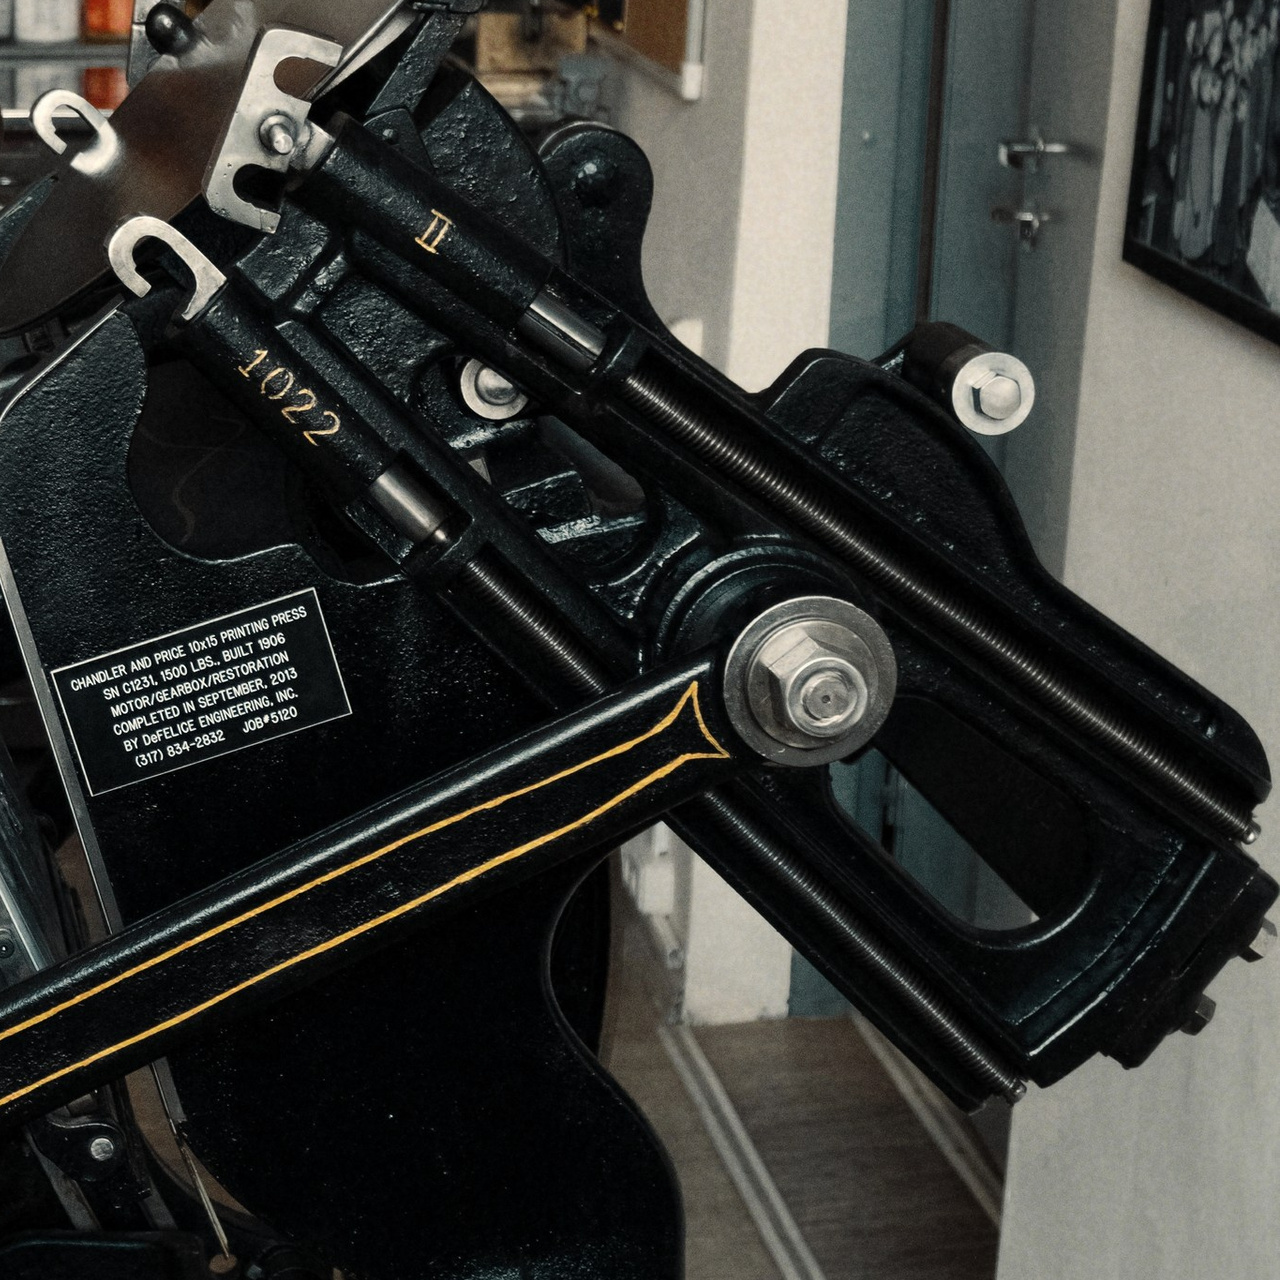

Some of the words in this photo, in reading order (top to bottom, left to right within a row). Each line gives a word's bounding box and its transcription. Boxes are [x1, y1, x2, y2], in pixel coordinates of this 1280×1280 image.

[238, 349, 340, 445] 1022
[70, 664, 128, 692] CHANDLER
[130, 656, 152, 673] AND
[153, 644, 187, 665] PRICE
[188, 634, 218, 654] 10x15
[219, 618, 270, 644] PRINTING
[270, 605, 307, 627] PRESS
[102, 685, 120, 700] SN
[122, 674, 158, 694] C1231,
[160, 663, 188, 682] 1500
[189, 655, 221, 673] LBS.,
[221, 641, 254, 662] BUILT
[257, 632, 286, 650] 1906
[110, 650, 290, 718] MOTOR/GEARBOX/RESTORATION
[112, 704, 180, 736] COMPLETED
[182, 700, 196, 714] IN
[197, 677, 268, 709] SEPTEMBER,
[269, 666, 298, 686] 2013
[122, 736, 138, 752] BY
[141, 718, 197, 746] DeFELICE
[197, 695, 274, 728] ENGINEERING,
[275, 687, 299, 703] INC.
[134, 748, 164, 768] (317)
[166, 729, 226, 758] 834-2832
[242, 705, 298, 733] JOB#5120
